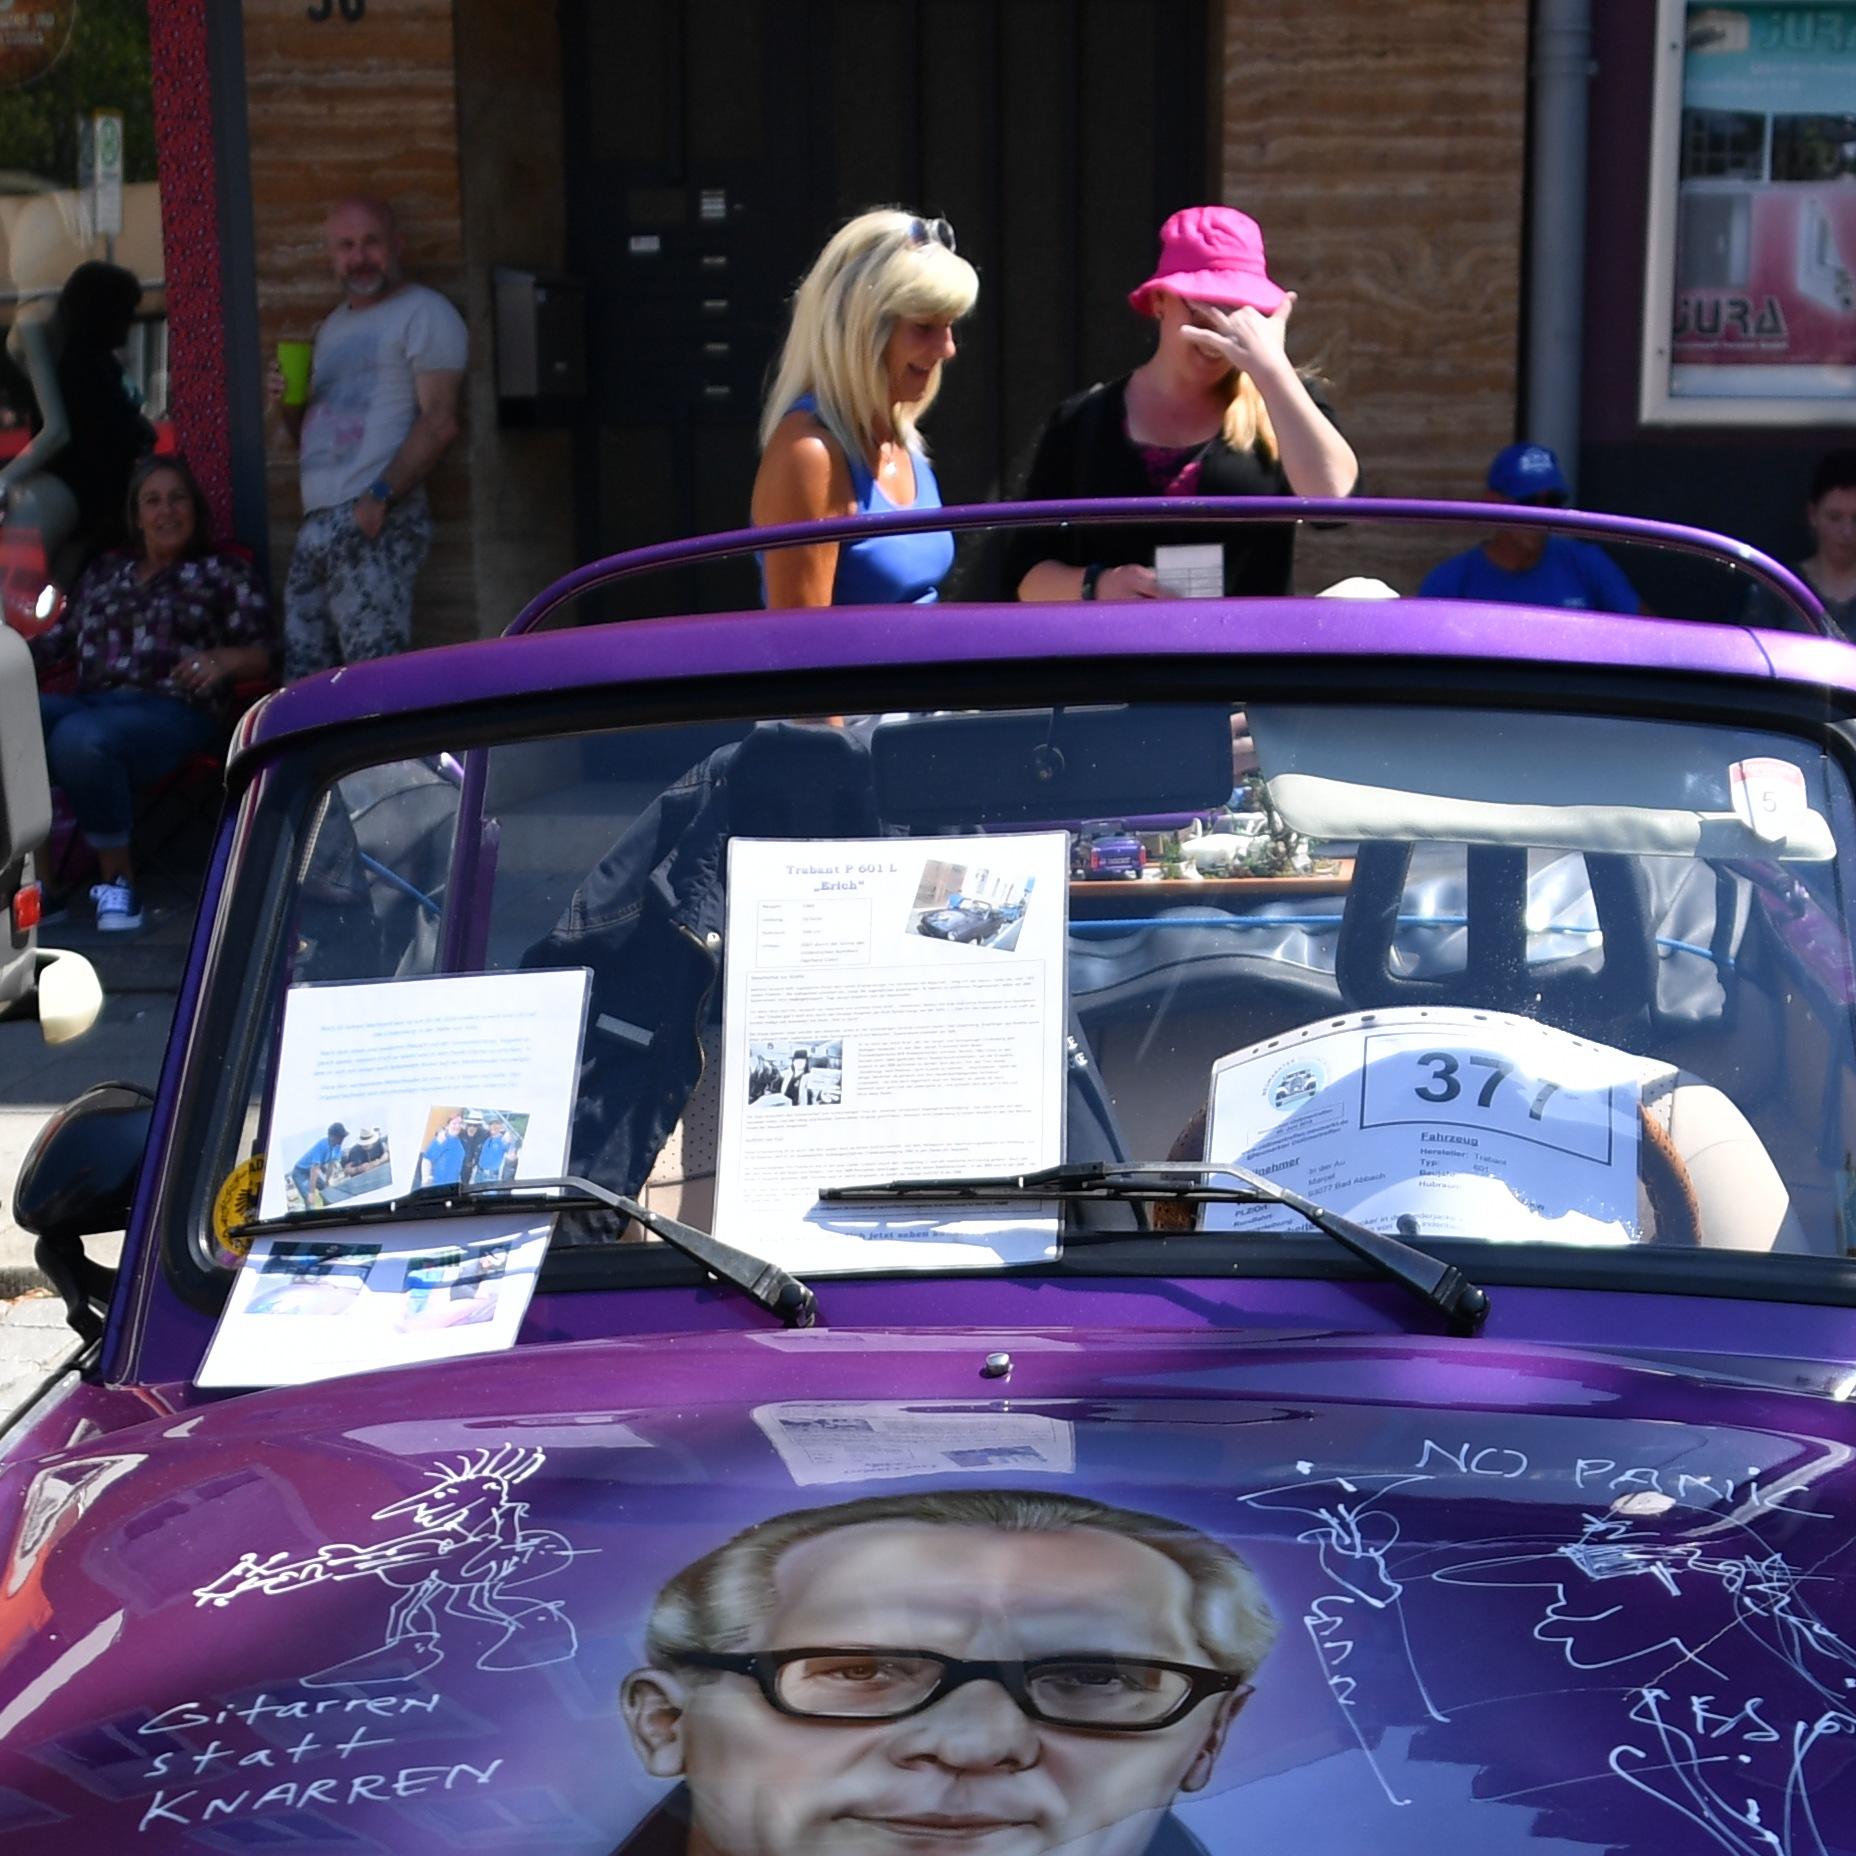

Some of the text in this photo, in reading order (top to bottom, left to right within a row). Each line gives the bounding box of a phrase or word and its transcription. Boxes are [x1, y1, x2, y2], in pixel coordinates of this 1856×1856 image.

[785, 865, 840, 875] Trabant
[858, 863, 884, 874] 601
[1420, 1131, 1479, 1148] Fahrzeug
[1415, 1438, 1529, 1479] NO
[137, 1693, 442, 1736] Gitarren
[144, 1726, 396, 1778] statt
[138, 1758, 505, 1832] KNARREN
